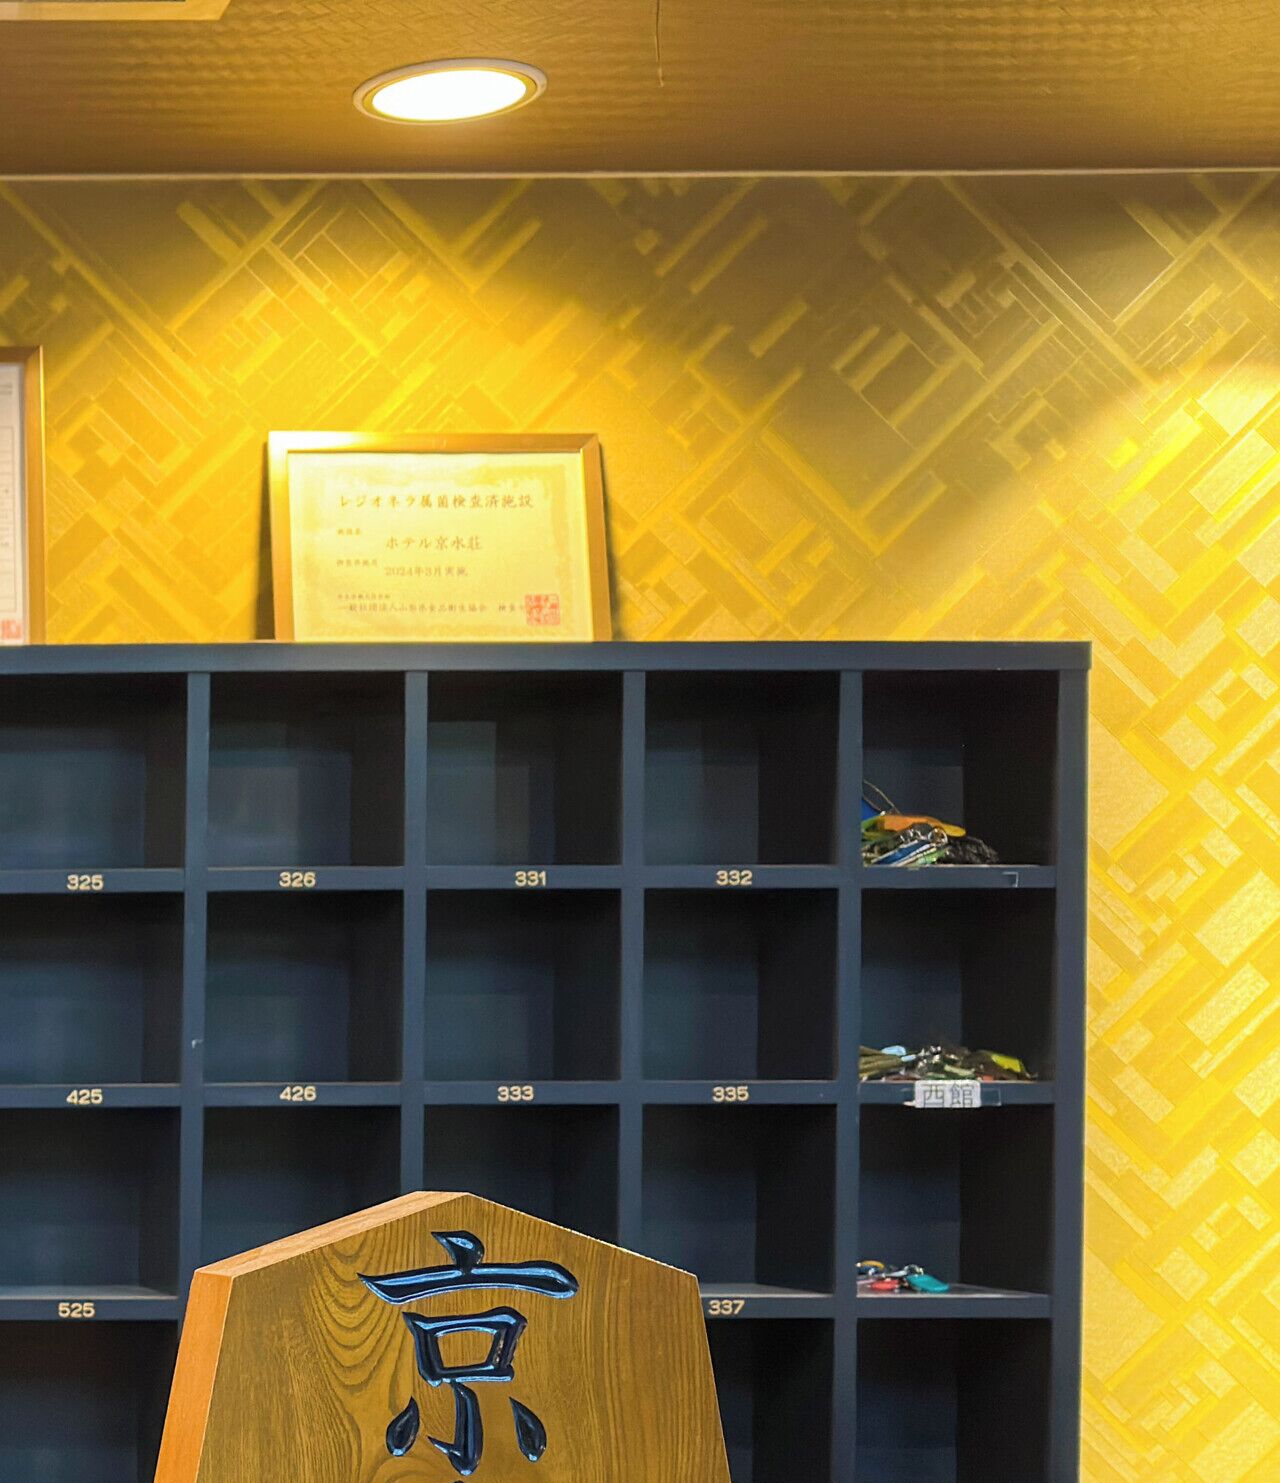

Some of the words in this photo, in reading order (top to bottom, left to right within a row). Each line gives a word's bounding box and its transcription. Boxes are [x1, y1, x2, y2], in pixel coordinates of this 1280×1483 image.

[66, 873, 104, 891] 325
[279, 870, 316, 888] 326
[514, 870, 546, 886] 331
[715, 869, 753, 886] 332
[66, 1087, 102, 1105] 425
[280, 1085, 316, 1101] 426
[498, 1085, 534, 1101] 333
[712, 1086, 749, 1102] 335
[921, 1083, 976, 1108] 西館
[57, 1302, 96, 1319] 525
[707, 1297, 745, 1317] 337
